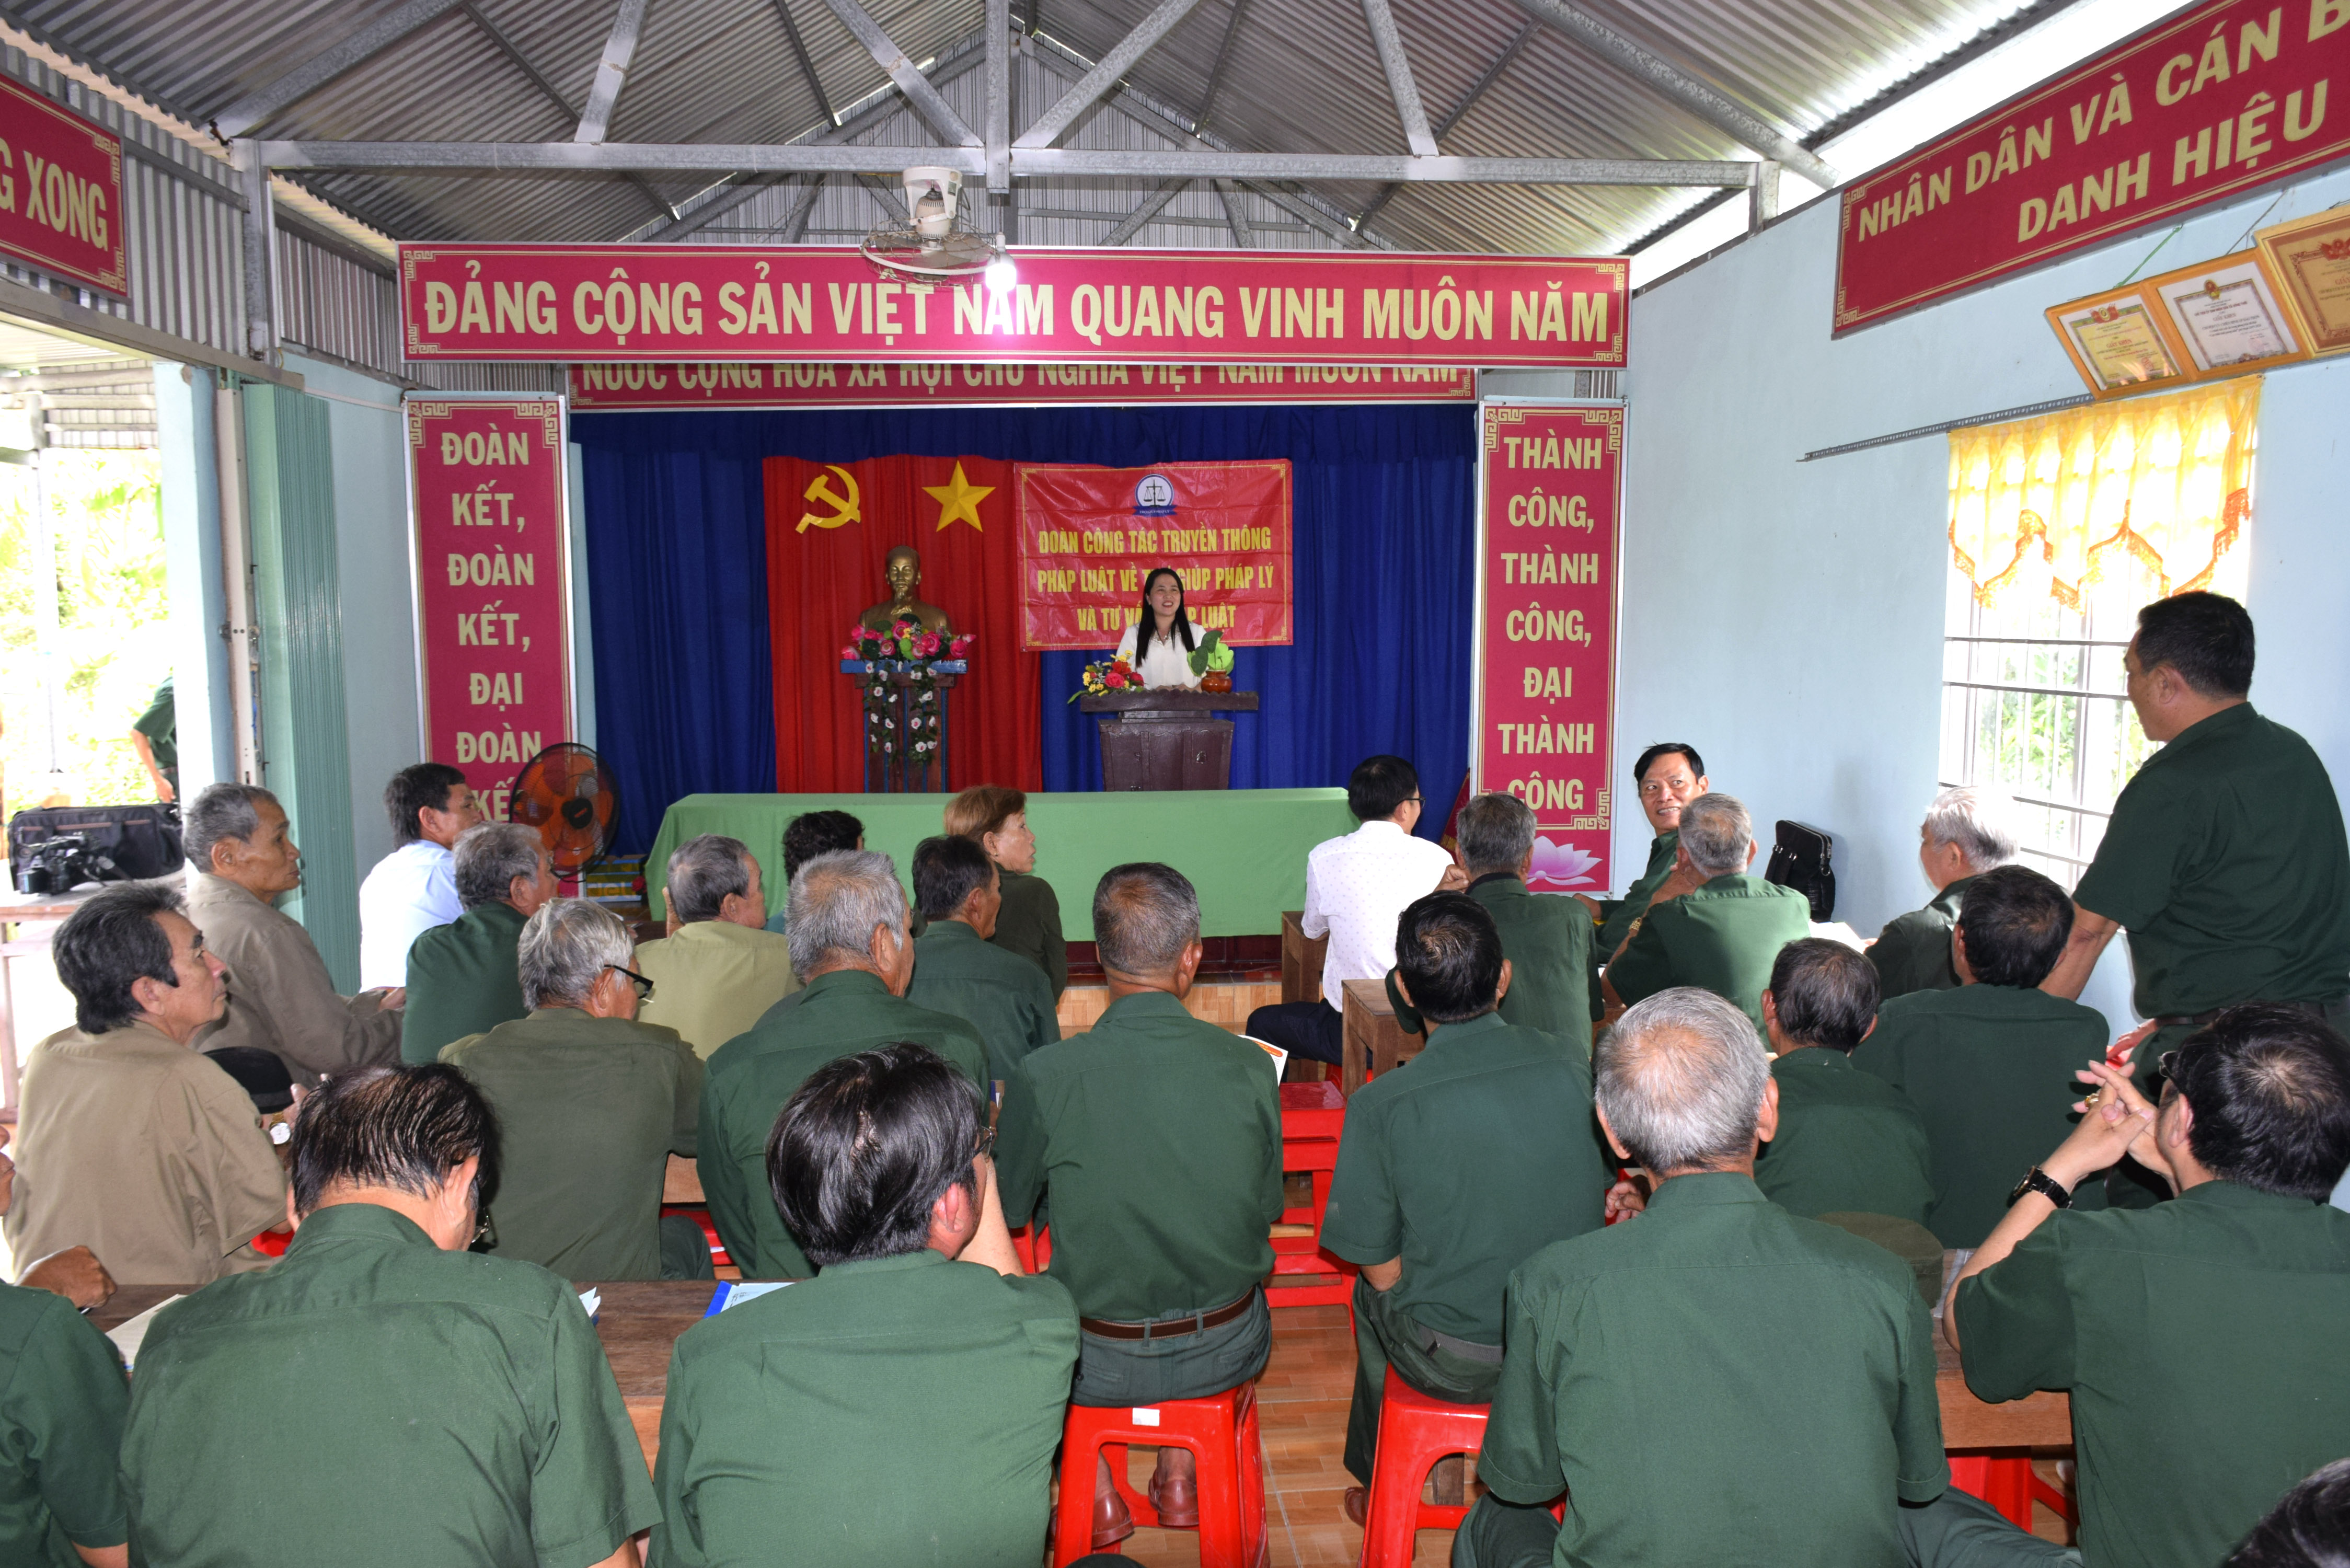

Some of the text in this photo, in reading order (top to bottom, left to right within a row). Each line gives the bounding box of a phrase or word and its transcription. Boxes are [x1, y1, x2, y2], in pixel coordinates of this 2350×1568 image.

[1859, 166, 1952, 242] NHÂN
[1966, 117, 2052, 194] DÂN
[2070, 73, 2132, 144] VÀ
[2156, 8, 2281, 107] CÁN
[2018, 79, 2328, 243] DANH HIỆU
[25, 152, 107, 249] XONG
[425, 260, 1608, 345] ĐẢNG CỘNG SẢN VIỆT NAM QUANG VINH MUÔN NĂM
[441, 423, 528, 466] ĐOÀN
[1504, 429, 1602, 469] THÀNH
[452, 480, 525, 533] KẾT,
[1508, 486, 1594, 533] CÔNG,
[1039, 522, 1271, 554] ĐOÀN CÔNG TÁC TRUYỀN THÔNG
[447, 545, 534, 586] ĐOÀN
[1038, 566, 1076, 592] PHÁP
[1081, 566, 1115, 596] LUẬT
[1120, 562, 1138, 591] VỀ
[1177, 564, 1211, 591] GIÚP
[1216, 563, 1254, 590] PHÁP
[1259, 562, 1274, 588] LÝ
[1501, 544, 1598, 584] THÀNH
[458, 600, 530, 652] KẾT,
[1077, 605, 1097, 630] VÀ
[1101, 605, 1121, 630] TƯ
[1202, 602, 1236, 632] LUẬT
[1506, 601, 1592, 647] CÔNG,
[469, 673, 522, 711] ĐẠI
[1524, 667, 1572, 705] ĐẠI
[456, 723, 542, 764] ĐOÀN
[1497, 715, 1594, 754] THÀNH
[471, 777, 515, 821] KẾ
[1507, 771, 1584, 810] CÔNG
